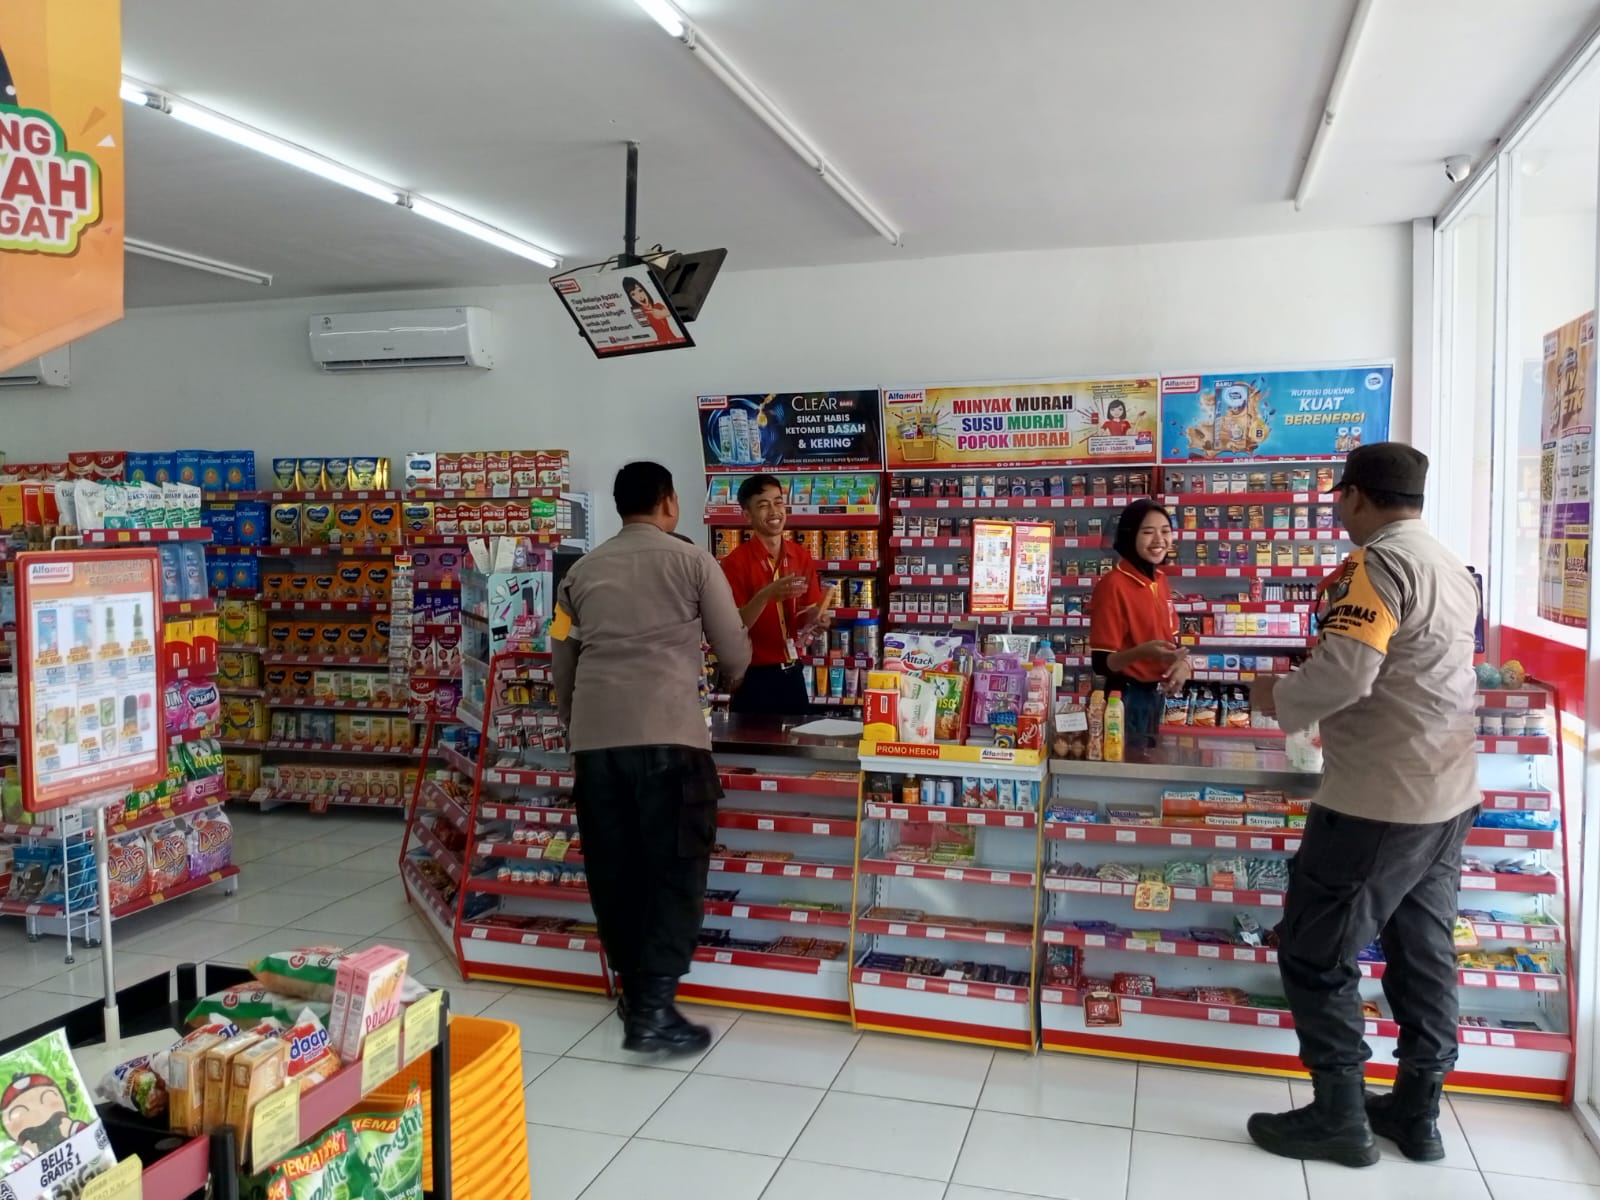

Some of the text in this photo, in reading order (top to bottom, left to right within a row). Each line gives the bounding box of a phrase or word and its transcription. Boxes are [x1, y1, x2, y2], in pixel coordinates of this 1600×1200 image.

[888, 391, 923, 400] Alfamart
[1290, 387, 1356, 397] NUTRISI DUKUNG
[791, 395, 838, 412] CLEAR
[952, 394, 1074, 415] MINYAK MURAH
[1298, 396, 1345, 412] KUAT
[796, 413, 850, 424] SIKAT HABIS
[961, 413, 1065, 432] SUSU MURAH
[1284, 411, 1366, 426] BERENERGI
[785, 423, 866, 435] KETOMBE BASAH
[798, 439, 807, 449] &
[957, 431, 1070, 450] POPOK MURAH
[32, 565, 70, 575] Alfamart
[899, 651, 934, 666] Attack
[876, 744, 940, 756] PROMO HEBOH
[198, 822, 233, 853] Daia
[352, 1118, 399, 1132] HEMA
[40, 1143, 73, 1173] BELI 2
[40, 1158, 74, 1188] GRATIS
[75, 1153, 82, 1166] 1
